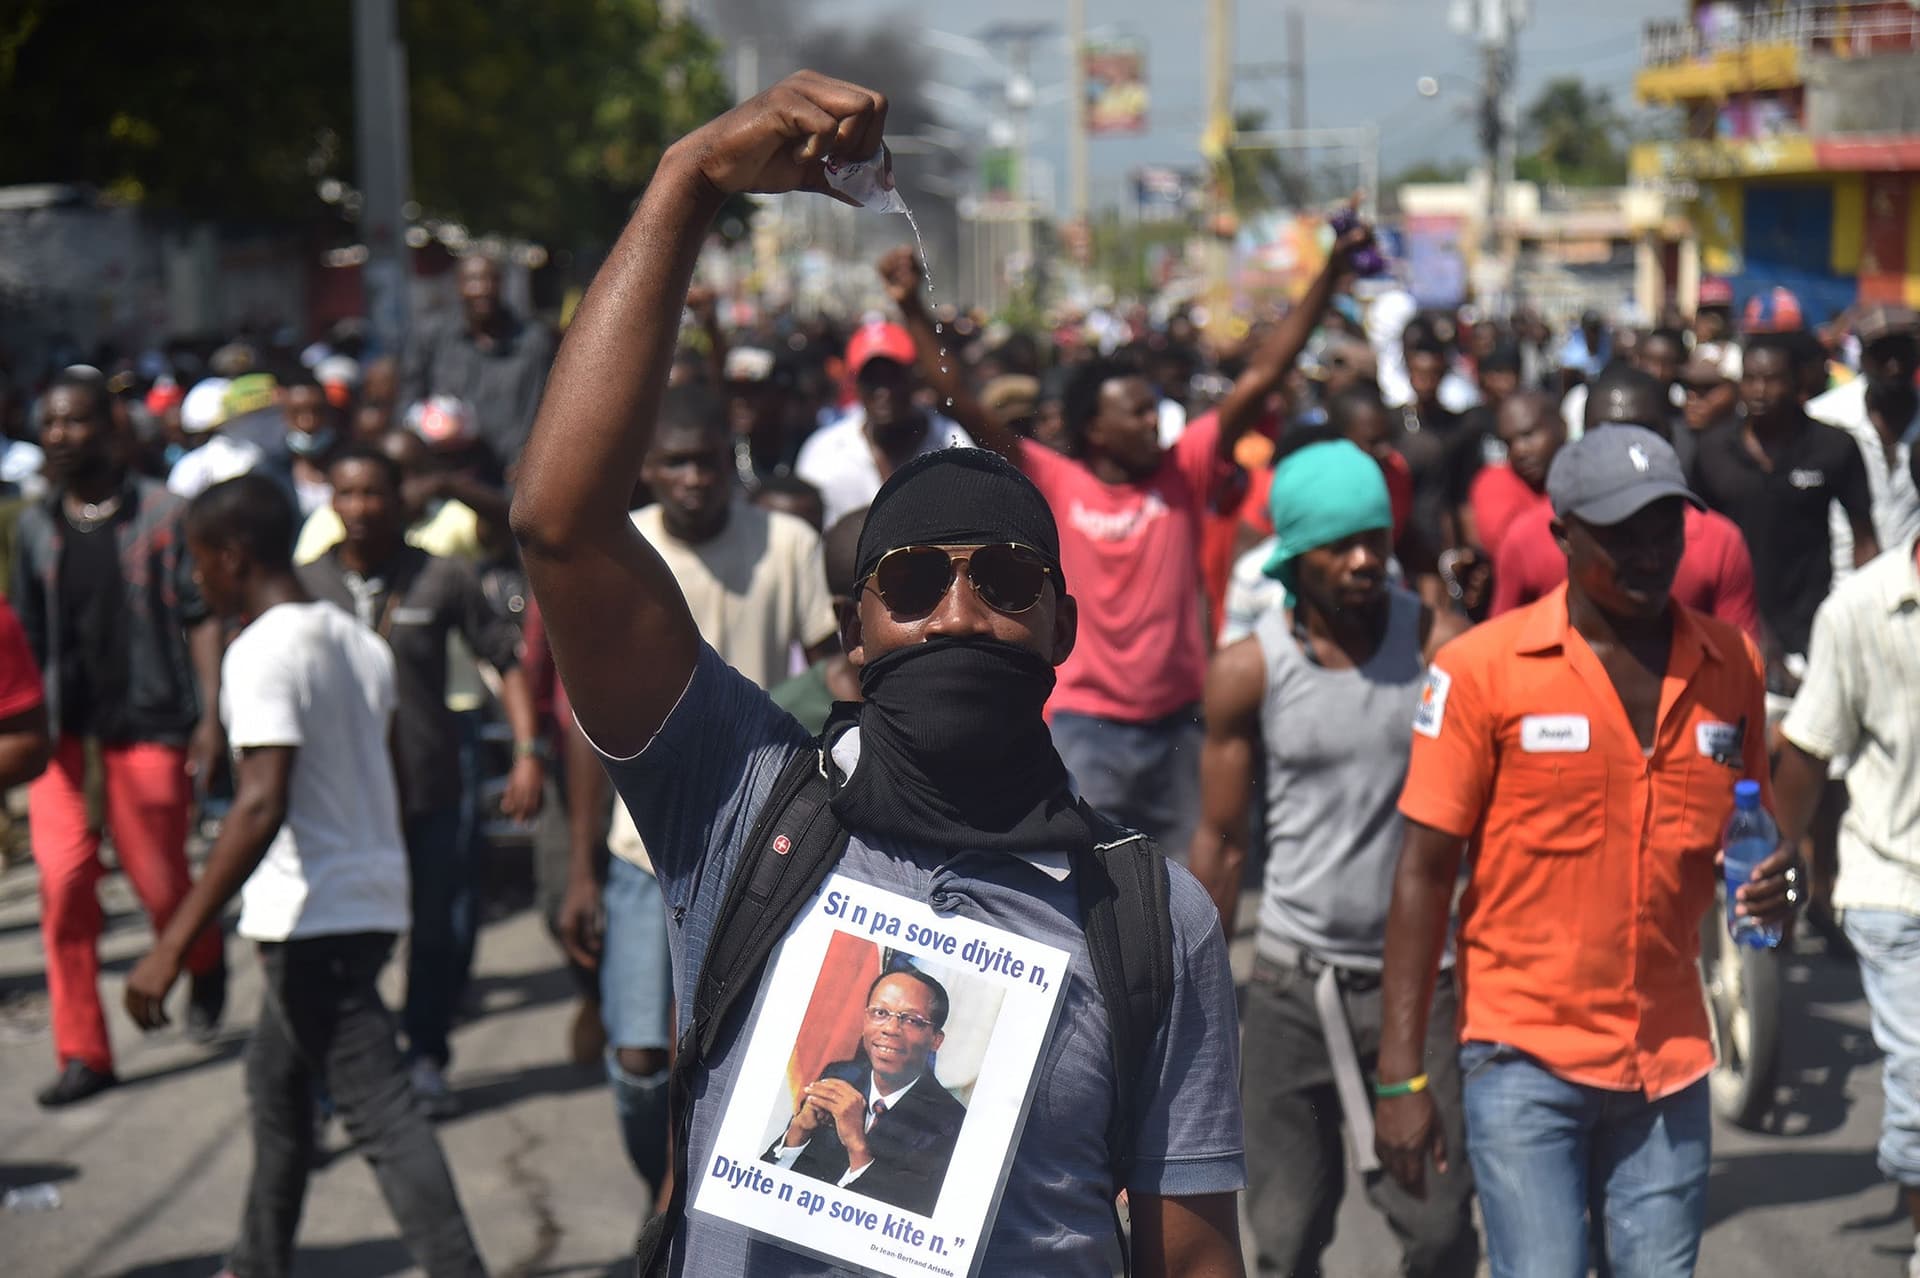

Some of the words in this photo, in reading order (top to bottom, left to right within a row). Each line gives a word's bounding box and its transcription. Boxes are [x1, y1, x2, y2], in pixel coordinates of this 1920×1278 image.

[851, 905, 867, 925] n
[869, 912, 901, 936] pa
[905, 923, 957, 955] sove
[961, 939, 1025, 979] diyite
[1028, 965, 1049, 993] n,
[711, 1155, 774, 1195] Diyite
[778, 1183, 793, 1202] n
[797, 1190, 825, 1216] ap
[828, 1201, 878, 1231] sove
[881, 1213, 925, 1247] kite
[870, 1243, 879, 1252] Dr
[879, 1247, 928, 1269] Jean-Bertrand
[927, 1264, 955, 1278] Aristide
